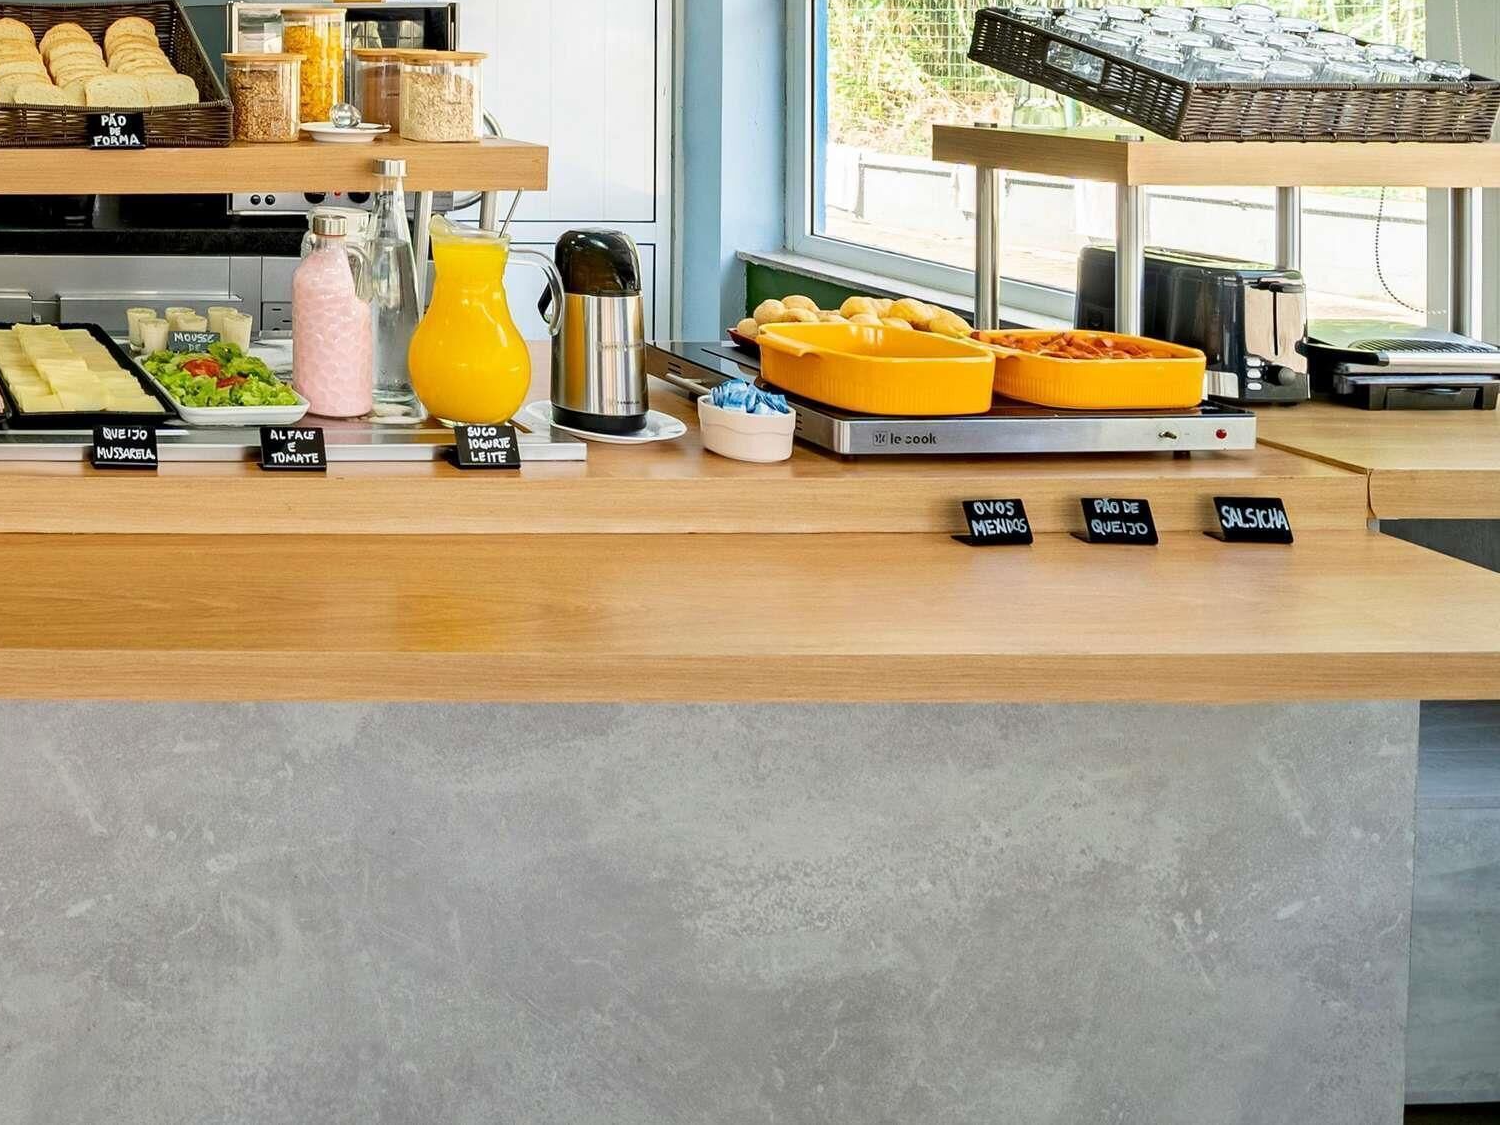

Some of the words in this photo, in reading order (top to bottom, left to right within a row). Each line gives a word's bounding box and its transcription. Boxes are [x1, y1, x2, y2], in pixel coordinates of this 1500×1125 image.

[100, 113, 127, 126] PÃO
[109, 127, 121, 136] DE
[93, 133, 141, 146] FORMA
[174, 332, 215, 342] MOUSSE
[102, 426, 148, 440] QUEIJO
[270, 429, 316, 440] ALFACE
[467, 426, 497, 437] SUCO
[467, 437, 511, 450] IOGURTE
[905, 433, 937, 444] cook
[97, 446, 156, 460] MUSSARELA
[287, 441, 297, 452] E
[271, 451, 319, 464] TOMATE
[470, 451, 507, 463] LEITE
[973, 501, 1015, 515] OVOS
[1122, 500, 1140, 514] DE
[1221, 505, 1289, 530] SALSICHA
[971, 517, 1028, 537] MEXIDOS
[1091, 519, 1149, 536] QUEIJO
